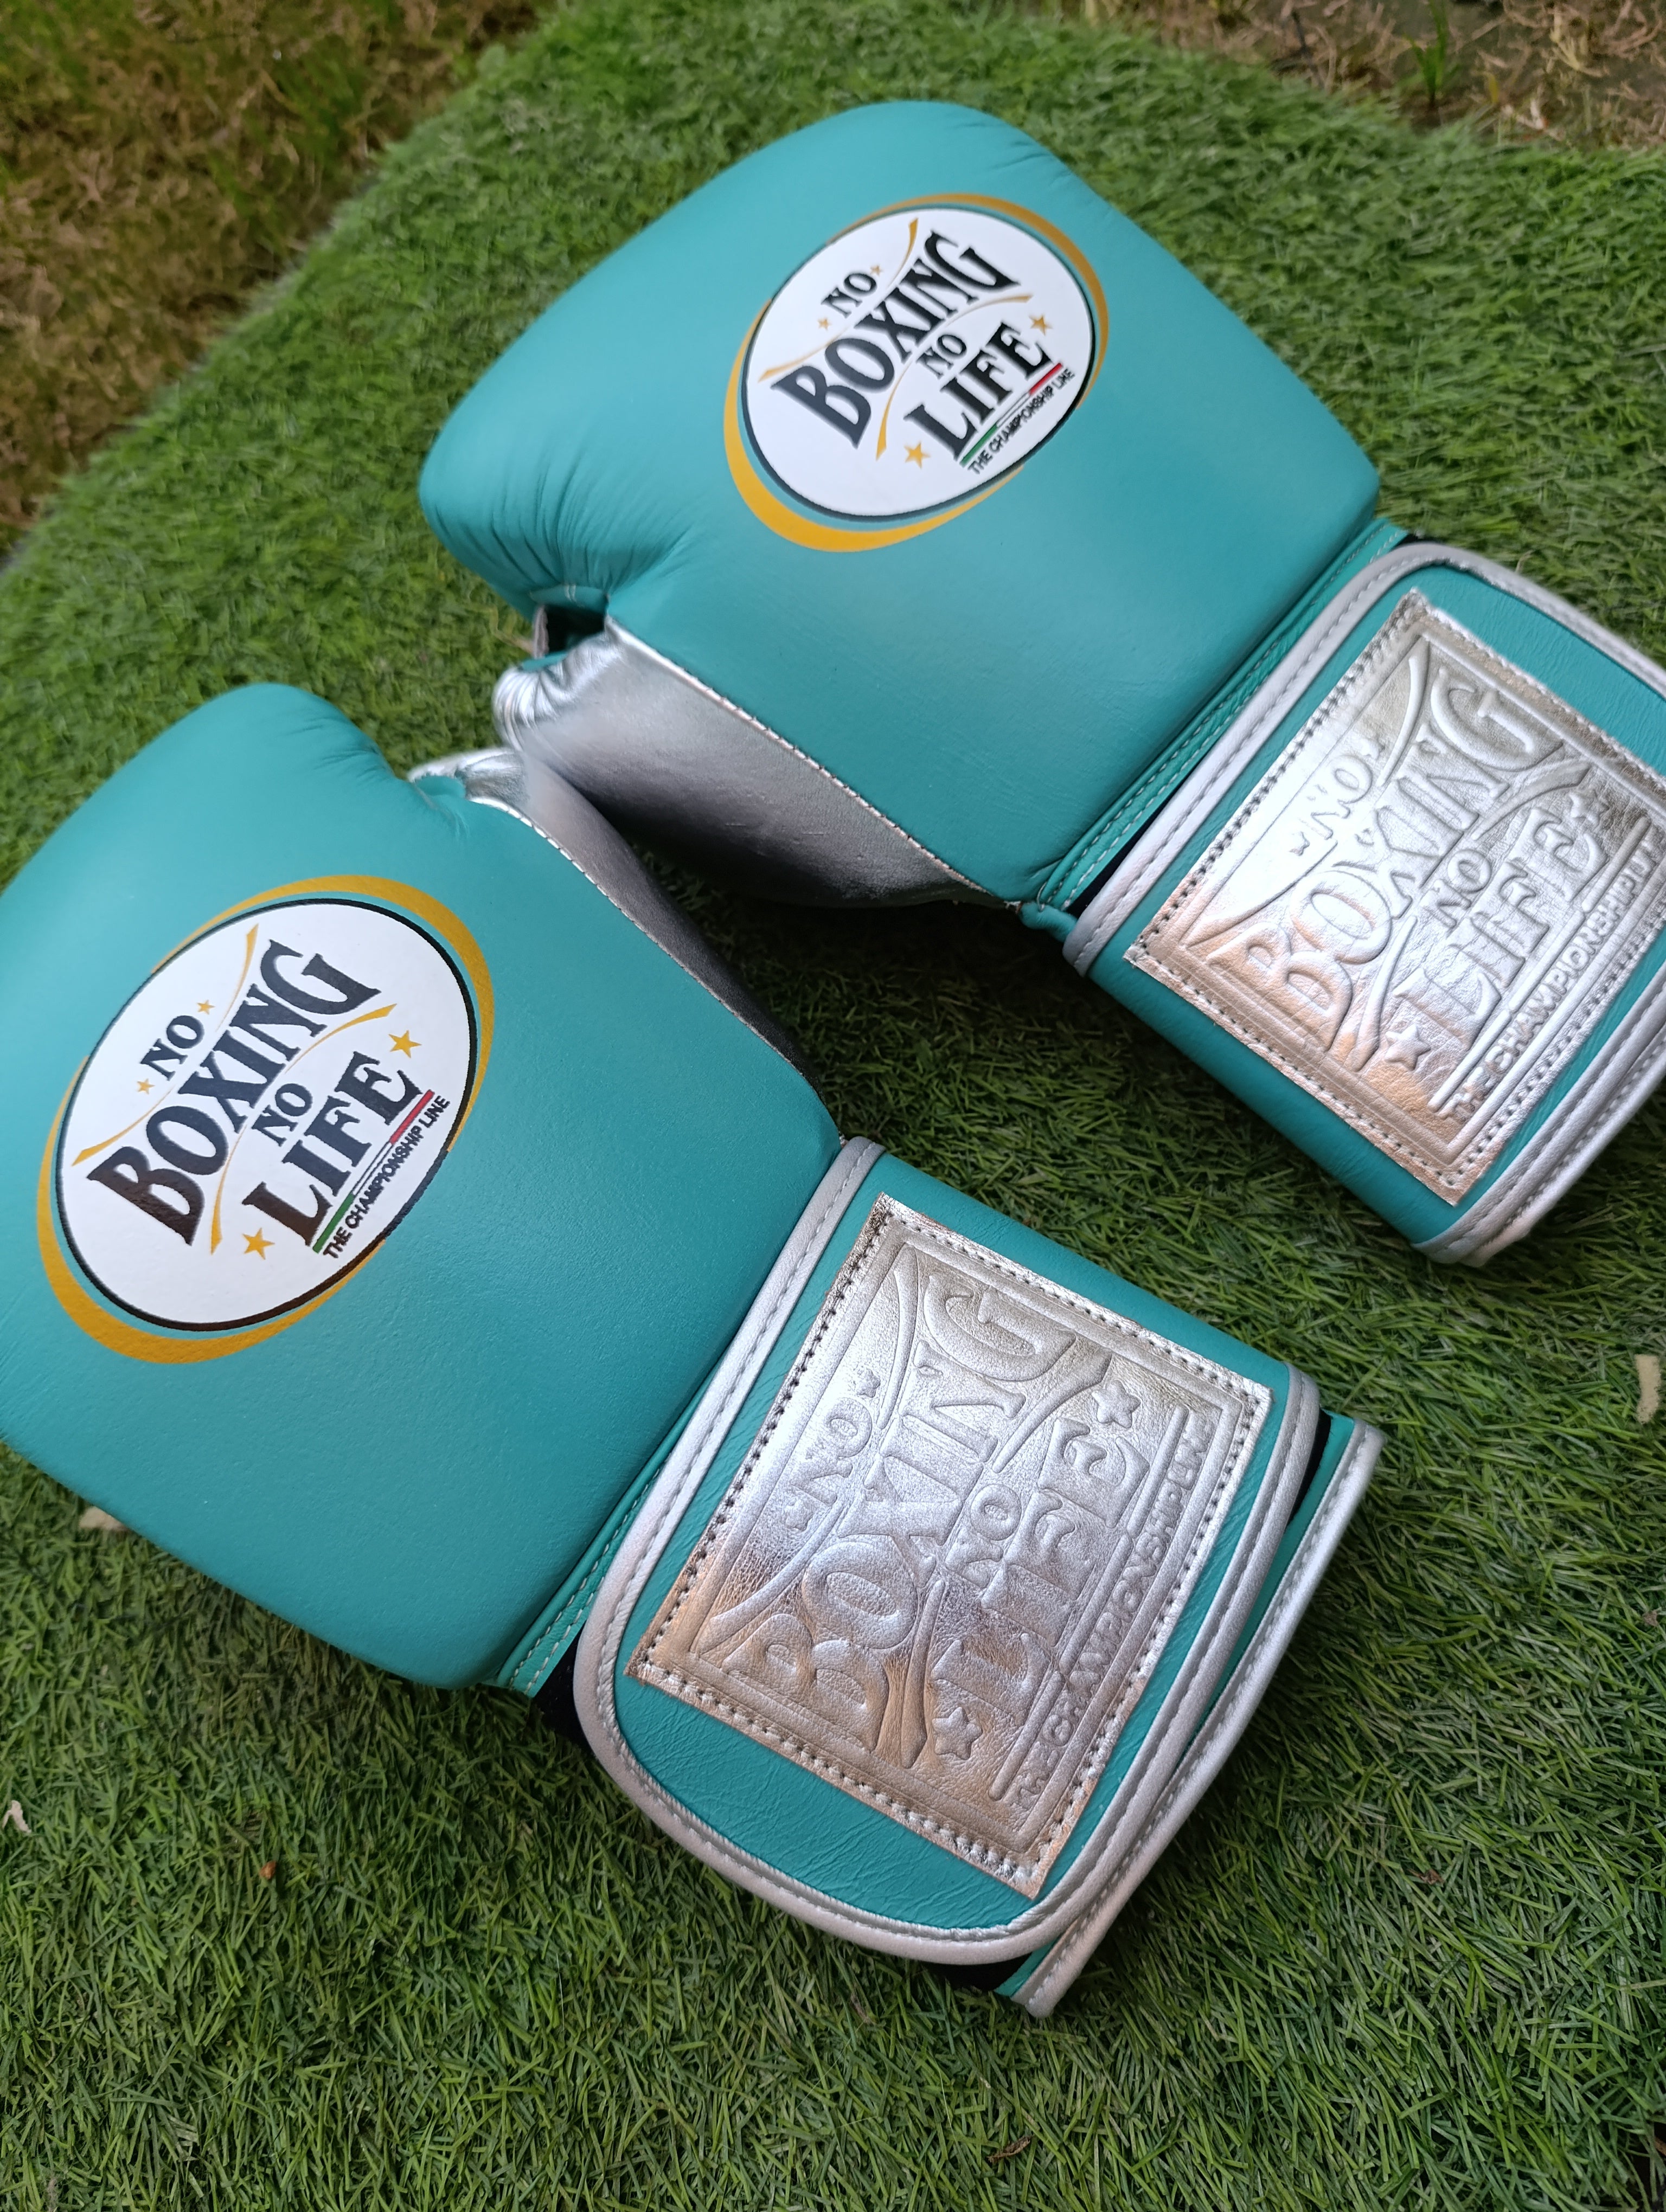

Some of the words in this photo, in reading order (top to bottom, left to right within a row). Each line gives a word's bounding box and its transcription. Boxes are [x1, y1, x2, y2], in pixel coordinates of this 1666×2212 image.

[770, 230, 1021, 449] BOXING
[821, 271, 877, 318] NO
[917, 333, 967, 379] NO
[904, 321, 1054, 461] LIFE
[967, 450, 993, 474] THE
[989, 385, 1054, 454] CHAMPIONSHIP
[1051, 368, 1075, 390] LINE
[1207, 667, 1563, 1052] BOXING
[1393, 807, 1609, 1051] LIFE
[1418, 848, 1492, 928] NO
[87, 938, 382, 1246] BOXING
[139, 1014, 205, 1082] NO
[251, 1082, 314, 1148] NO
[241, 1051, 423, 1247] LIFE
[323, 1226, 353, 1258] THE
[344, 1125, 424, 1229] CHAMPIONSHIP
[418, 1095, 451, 1128] LINE
[722, 1274, 1074, 1753] BOXING
[790, 1397, 872, 1507] NO
[931, 1417, 1150, 1728] LIFE
[945, 1483, 1022, 1589] NO
